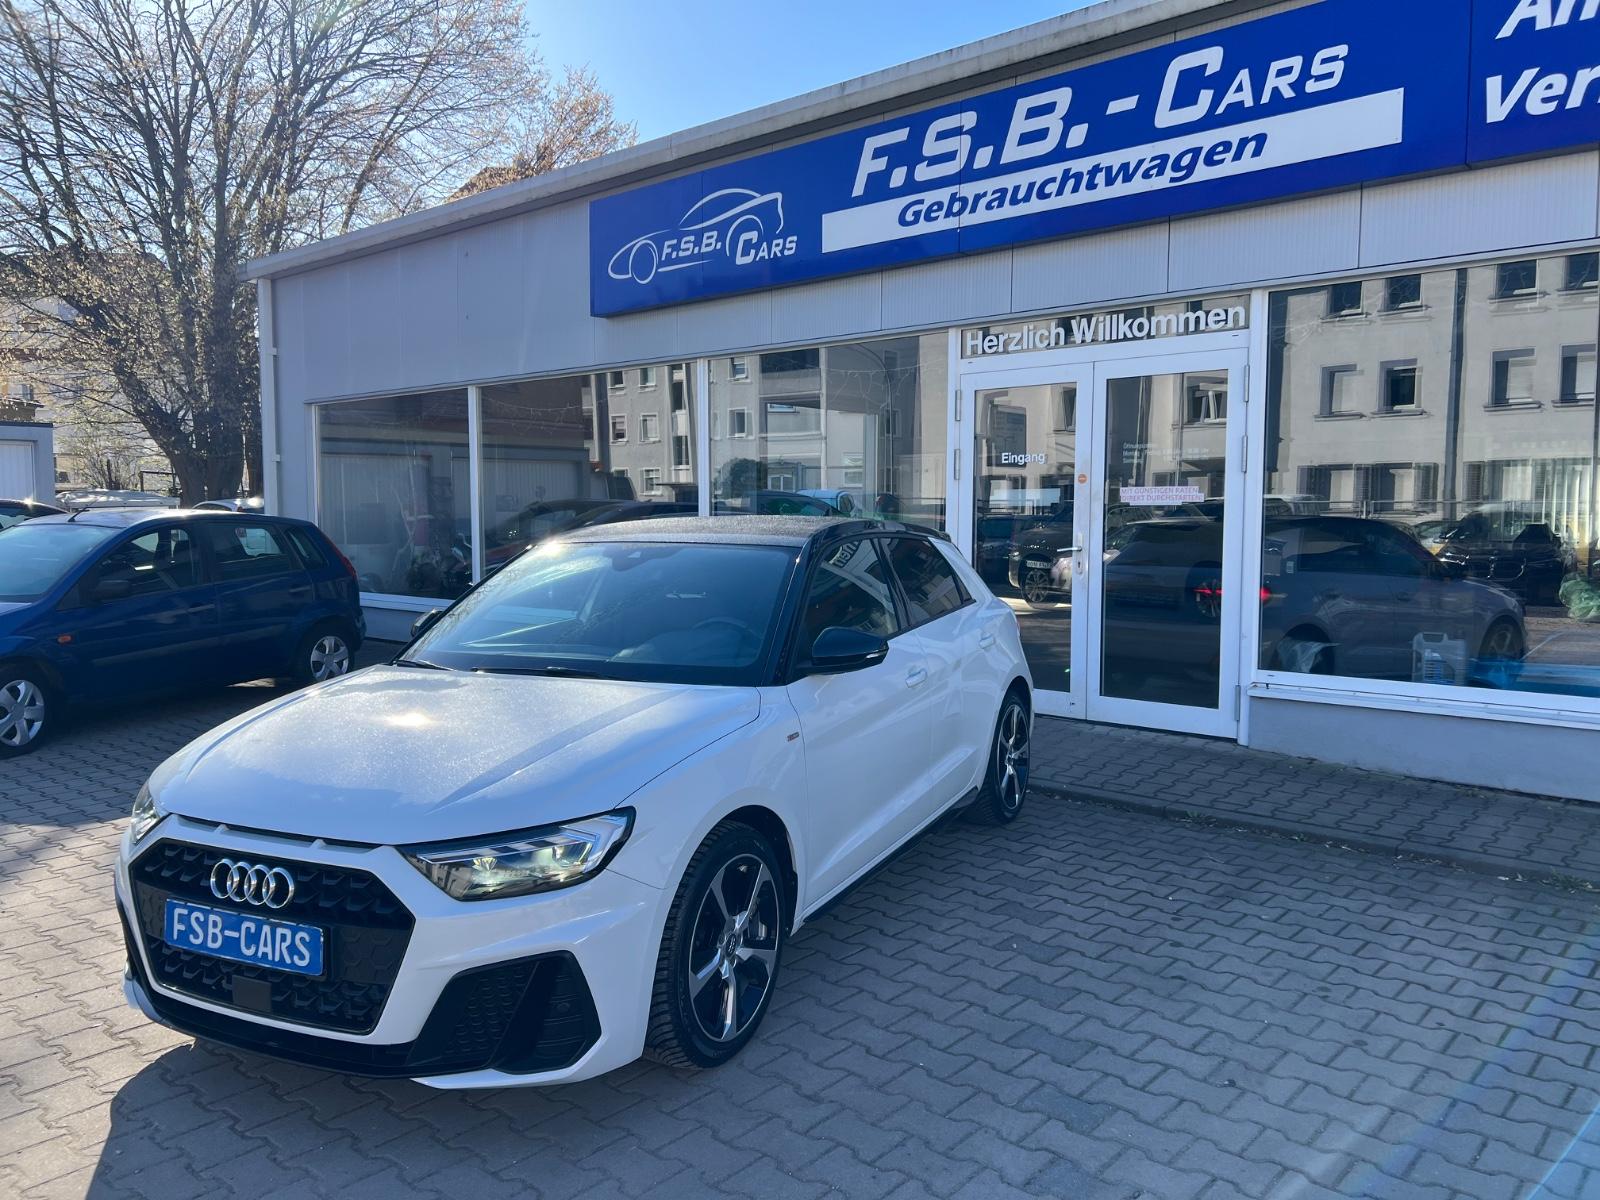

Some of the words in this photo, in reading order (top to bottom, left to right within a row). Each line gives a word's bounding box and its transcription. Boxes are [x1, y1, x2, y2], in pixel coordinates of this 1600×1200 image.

[898, 131, 1268, 228] Gebrauchtwagen
[661, 229, 722, 261] F.S.B.
[965, 319, 1065, 356] Herzlich
[1071, 305, 1246, 345] Willkommen
[1001, 452, 1045, 465] Eingang
[173, 907, 311, 967] FSB-CARS
